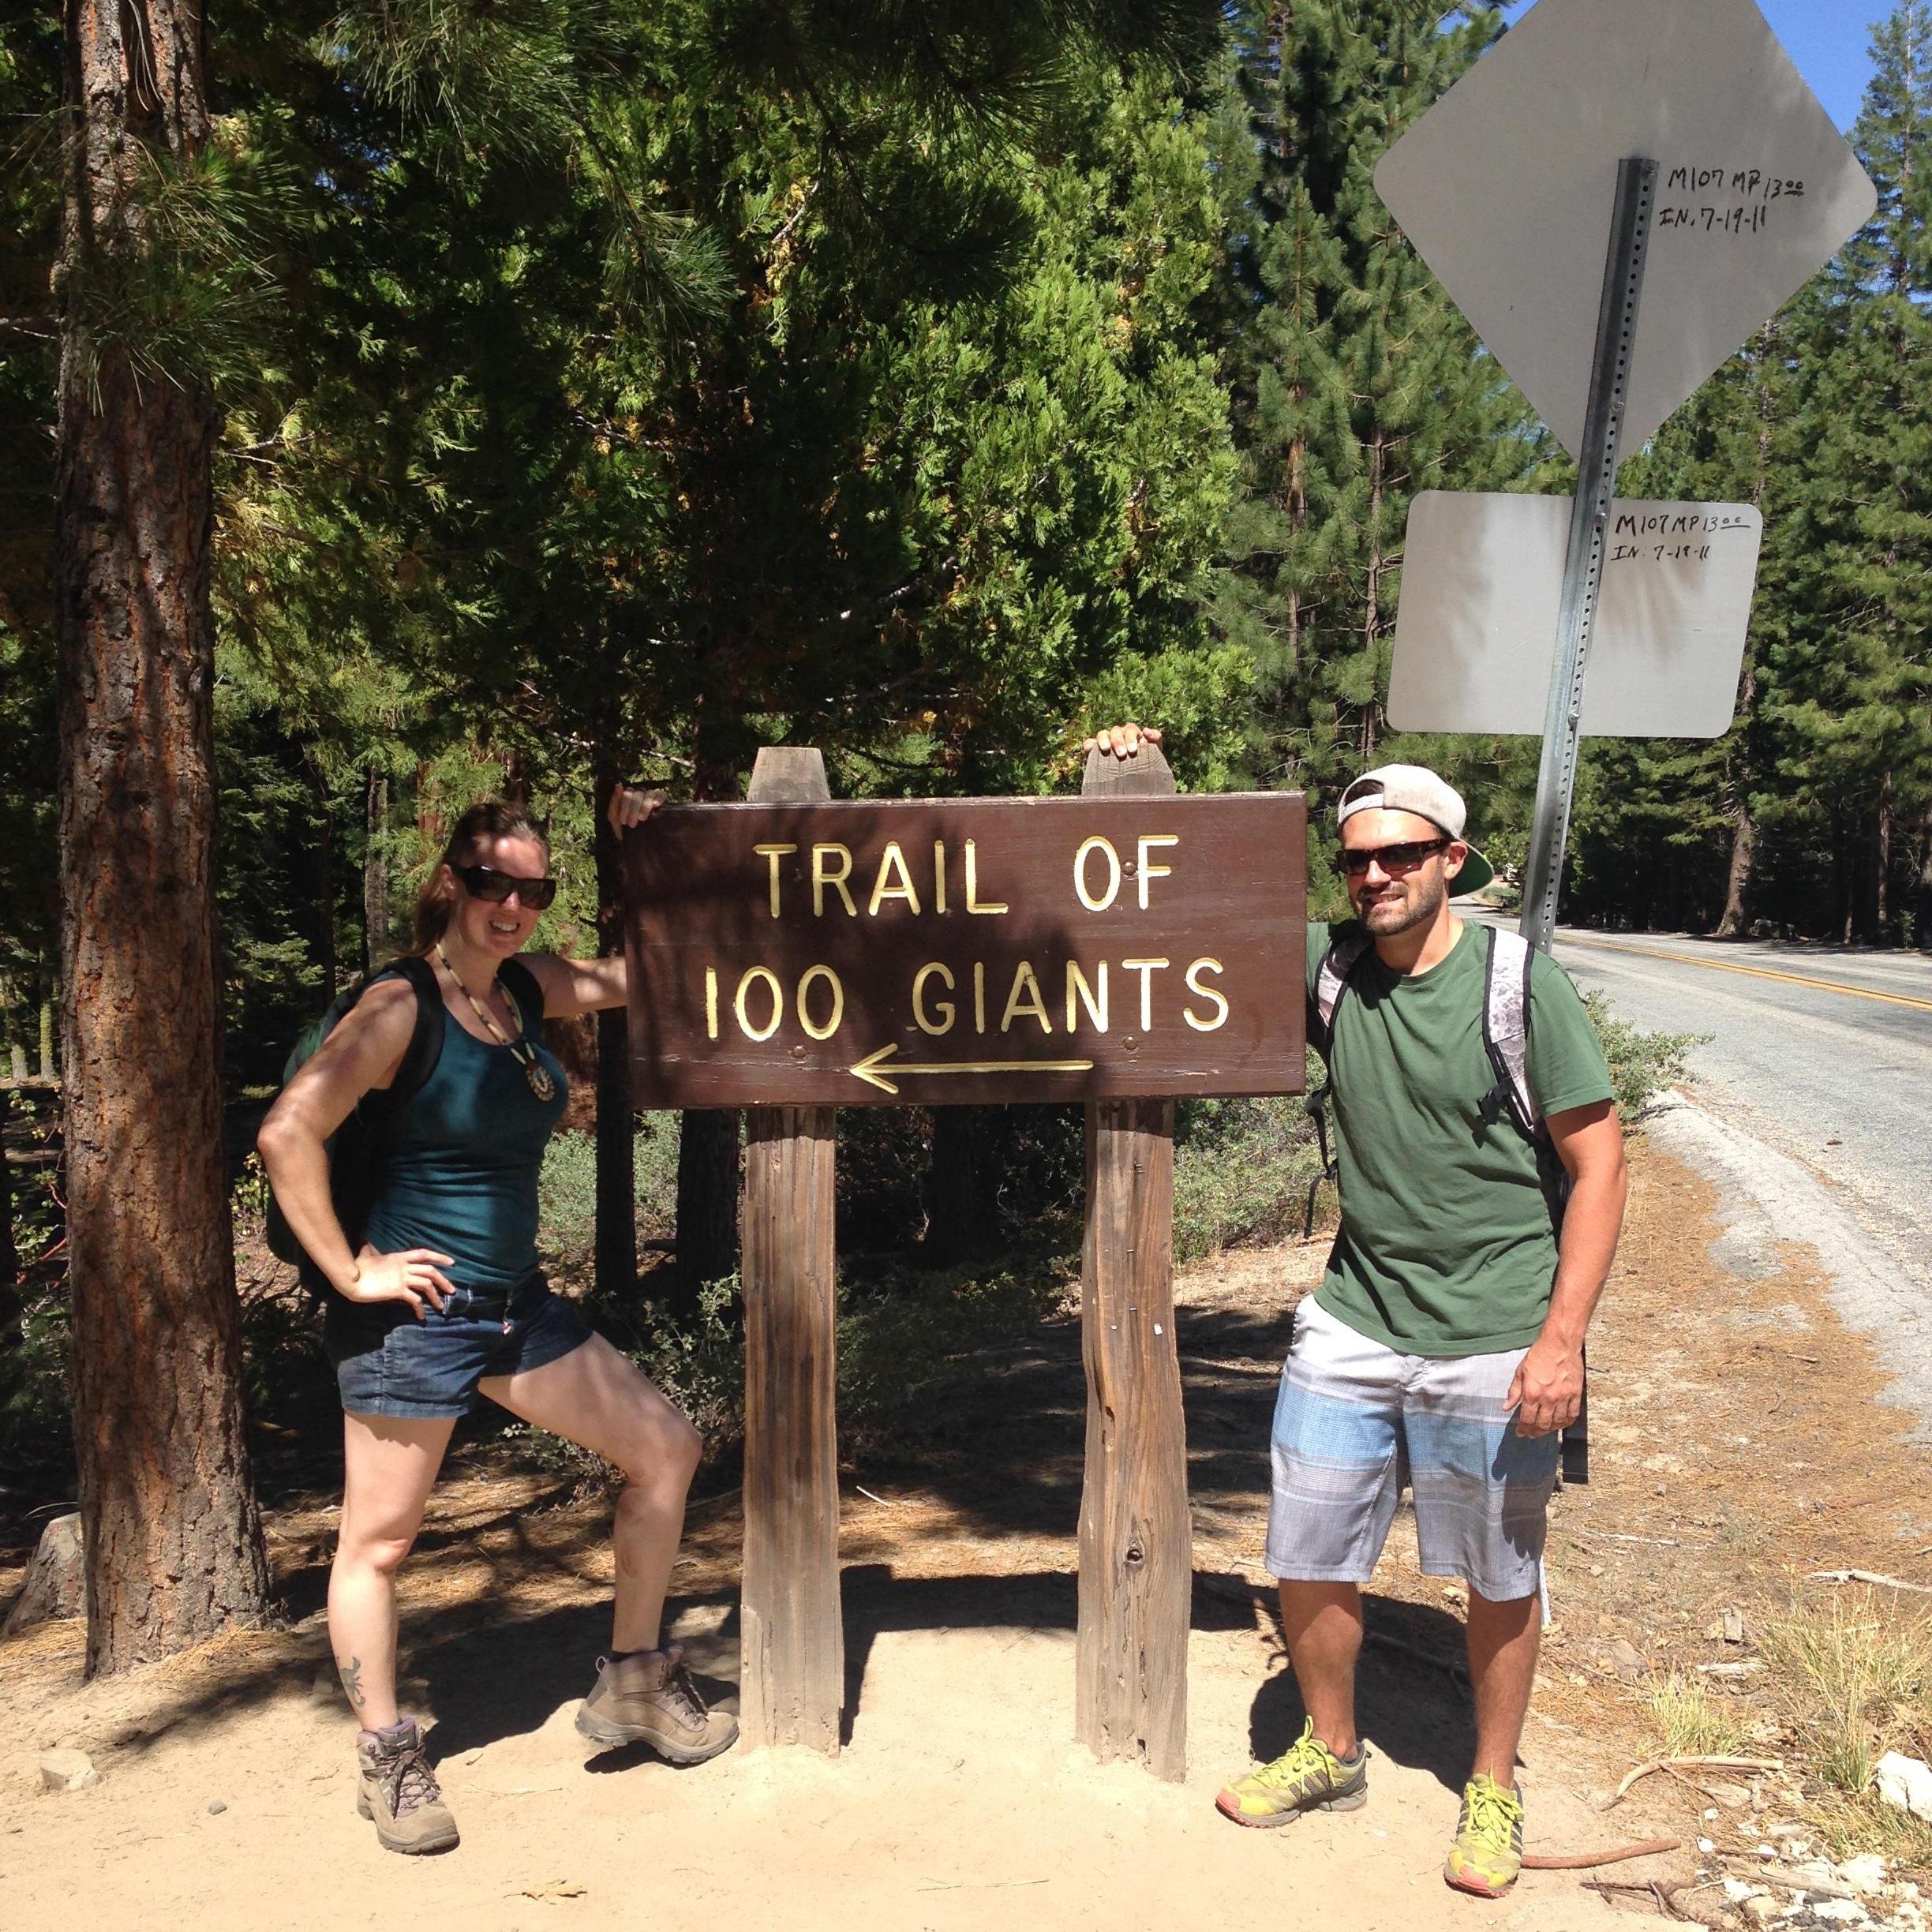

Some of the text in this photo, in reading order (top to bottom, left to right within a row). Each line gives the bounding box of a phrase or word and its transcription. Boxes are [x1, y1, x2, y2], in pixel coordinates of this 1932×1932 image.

[1668, 167, 1724, 193] M107
[1732, 169, 1762, 197] MP
[1701, 205, 1766, 234] 7-19-11
[1616, 515, 1669, 537] M107
[1671, 515, 1699, 533] MP
[752, 833, 1180, 920] TRAIL OF
[705, 956, 1230, 1043] 100 GIANTS
